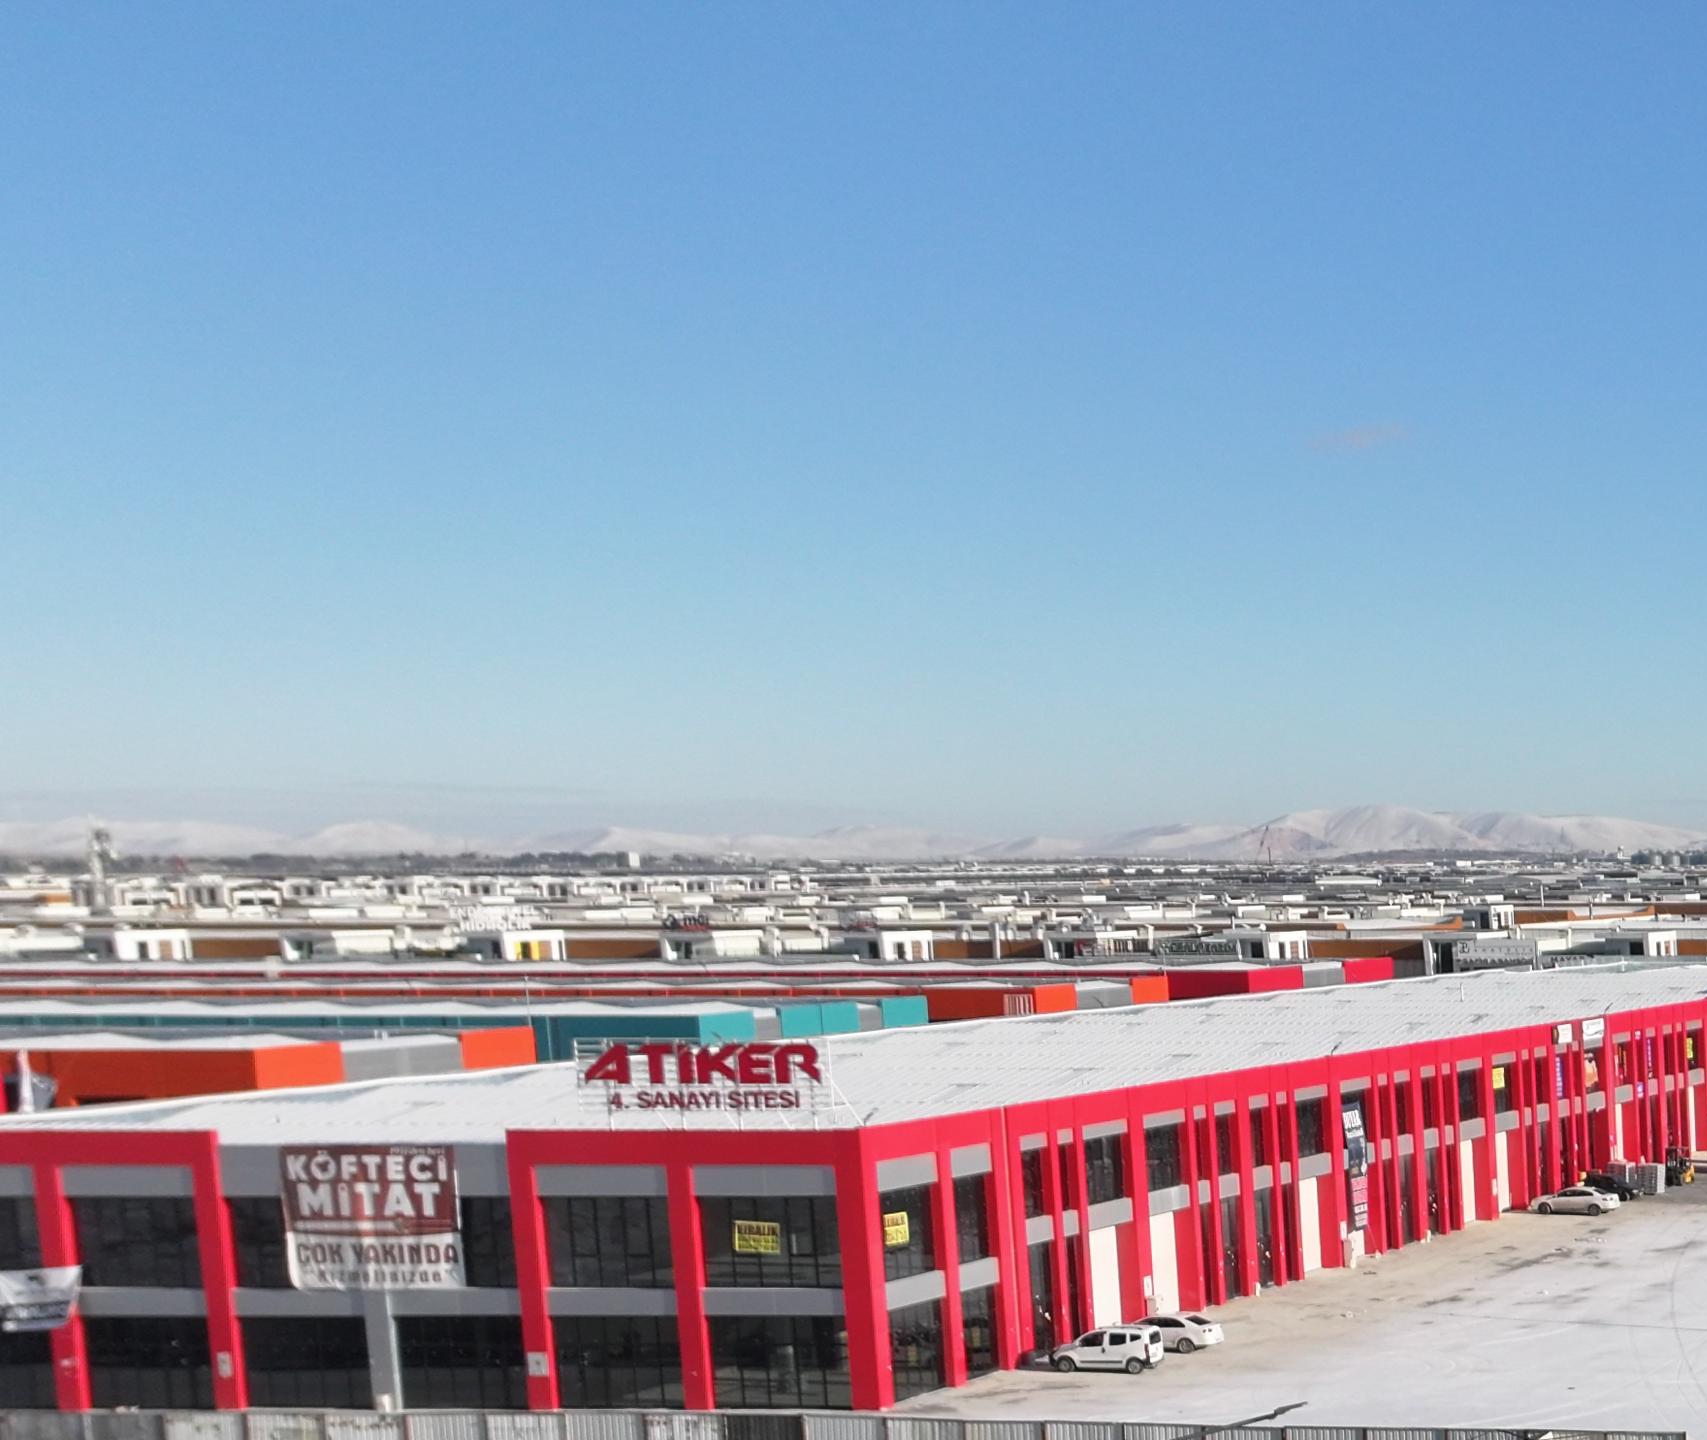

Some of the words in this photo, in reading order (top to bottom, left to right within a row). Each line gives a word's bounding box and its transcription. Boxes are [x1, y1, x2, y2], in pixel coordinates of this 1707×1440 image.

[286, 1151, 448, 1182] KÖFTECİ
[297, 1182, 441, 1217] MİTAT
[352, 1243, 459, 1265] YAKINDA
